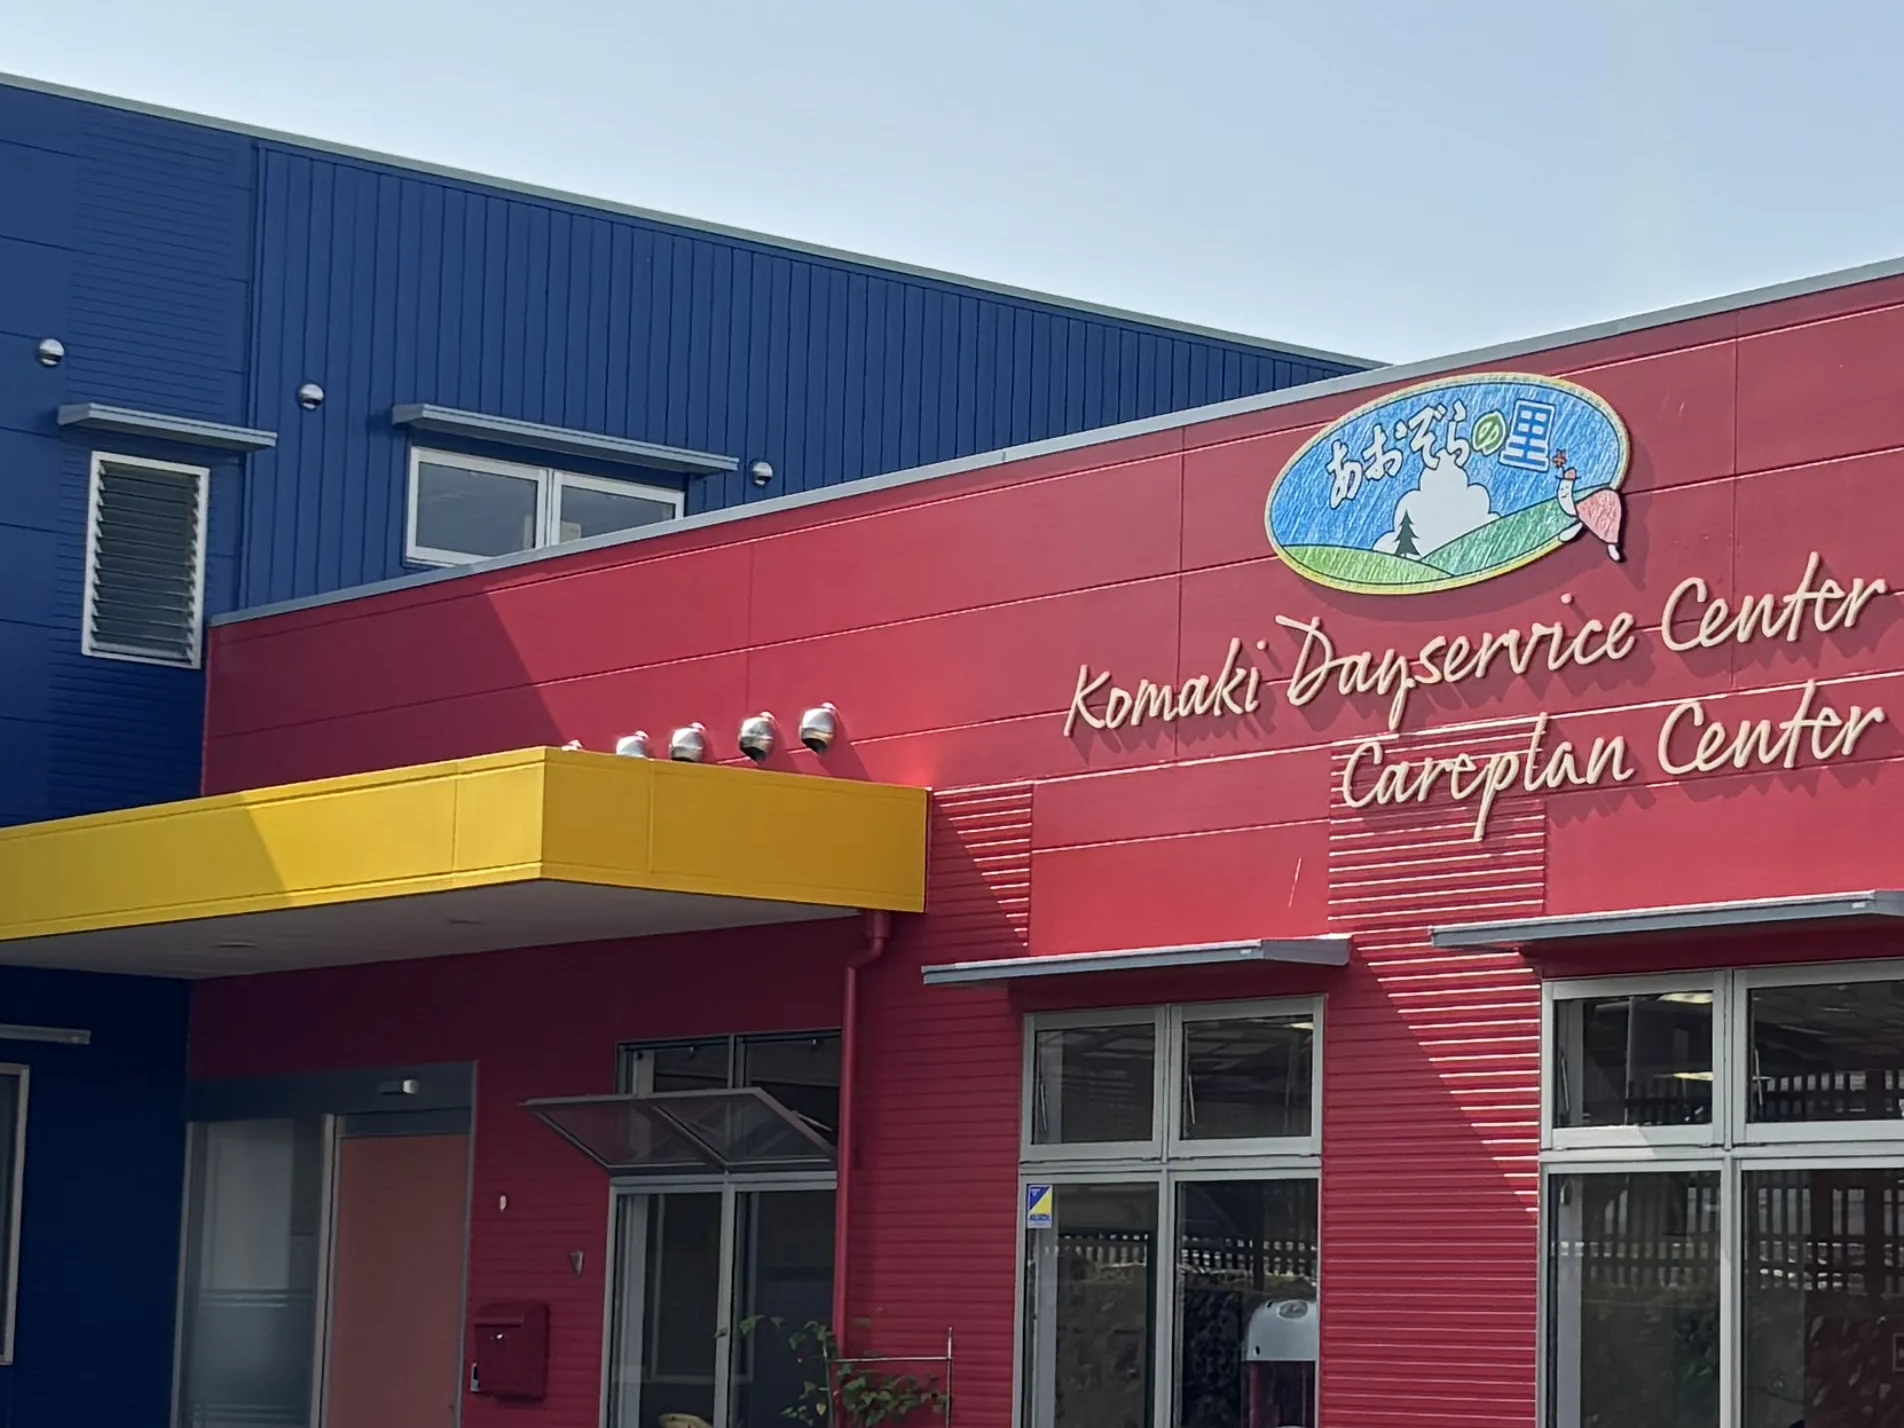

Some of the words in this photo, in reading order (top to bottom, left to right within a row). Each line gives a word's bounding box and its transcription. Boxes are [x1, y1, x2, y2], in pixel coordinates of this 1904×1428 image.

[1326, 399, 1556, 508] あおぞらの里
[1063, 638, 1269, 737] Komaki
[1275, 593, 1635, 729] Dayservice
[1660, 551, 1888, 652] Center
[1341, 712, 1635, 840] Careplan
[1657, 680, 1886, 777] Center
